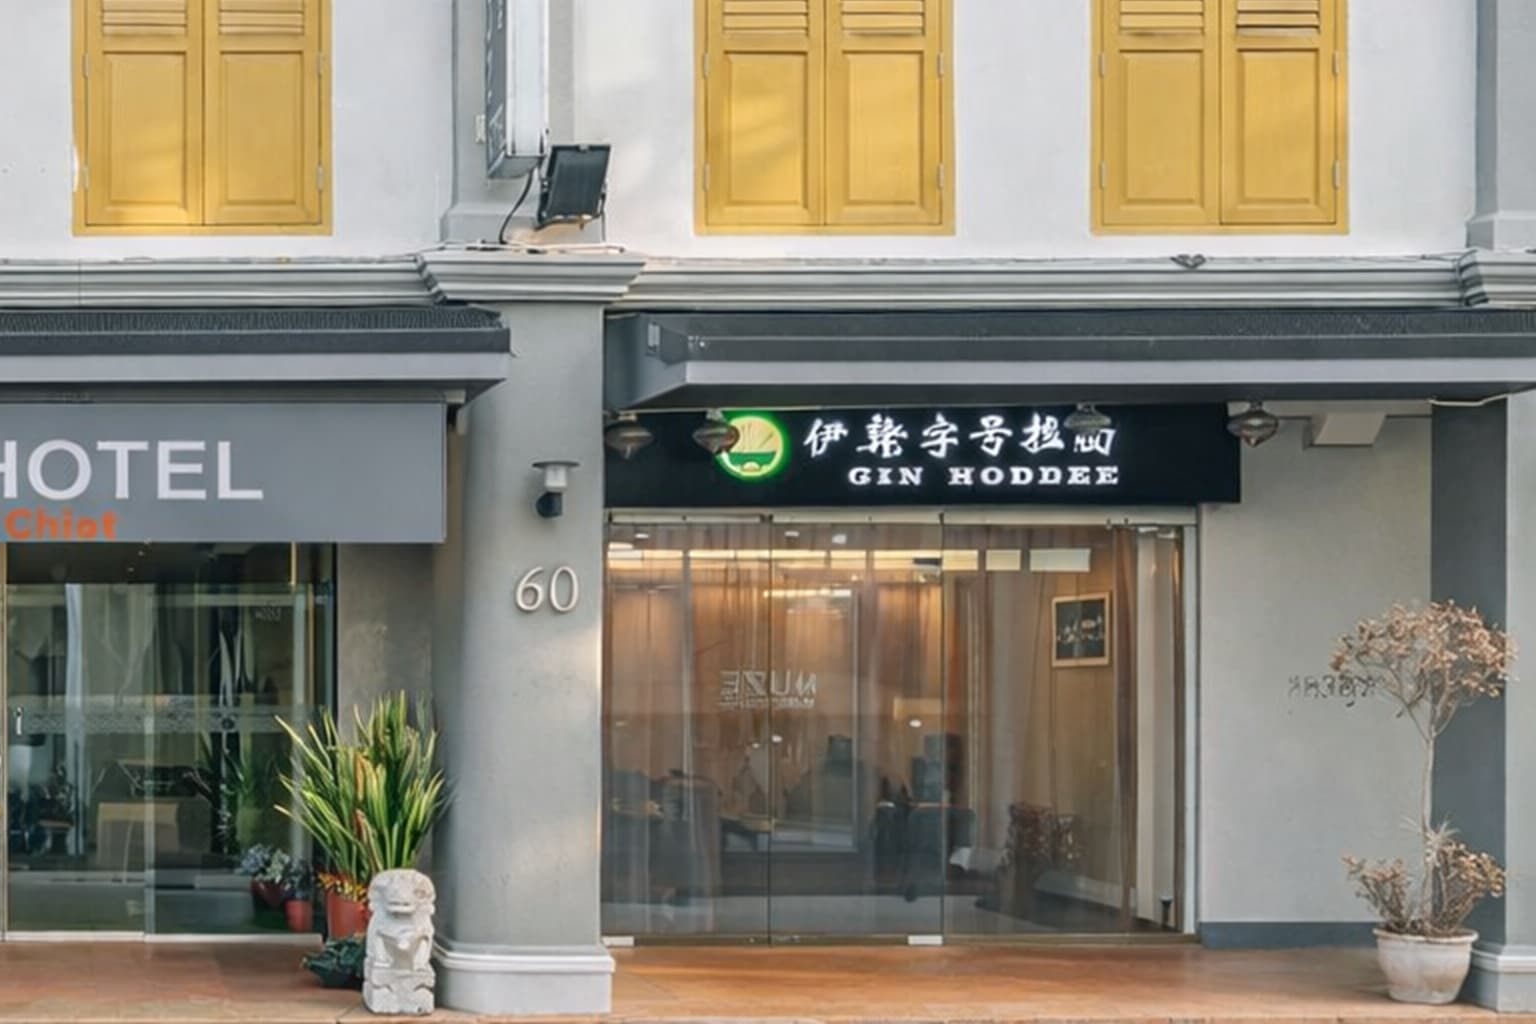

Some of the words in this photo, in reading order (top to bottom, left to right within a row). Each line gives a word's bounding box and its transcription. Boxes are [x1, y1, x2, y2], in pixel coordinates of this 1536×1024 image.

[848, 467, 923, 486] GIN
[4, 507, 117, 540] Chiat
[516, 566, 579, 611] 60
